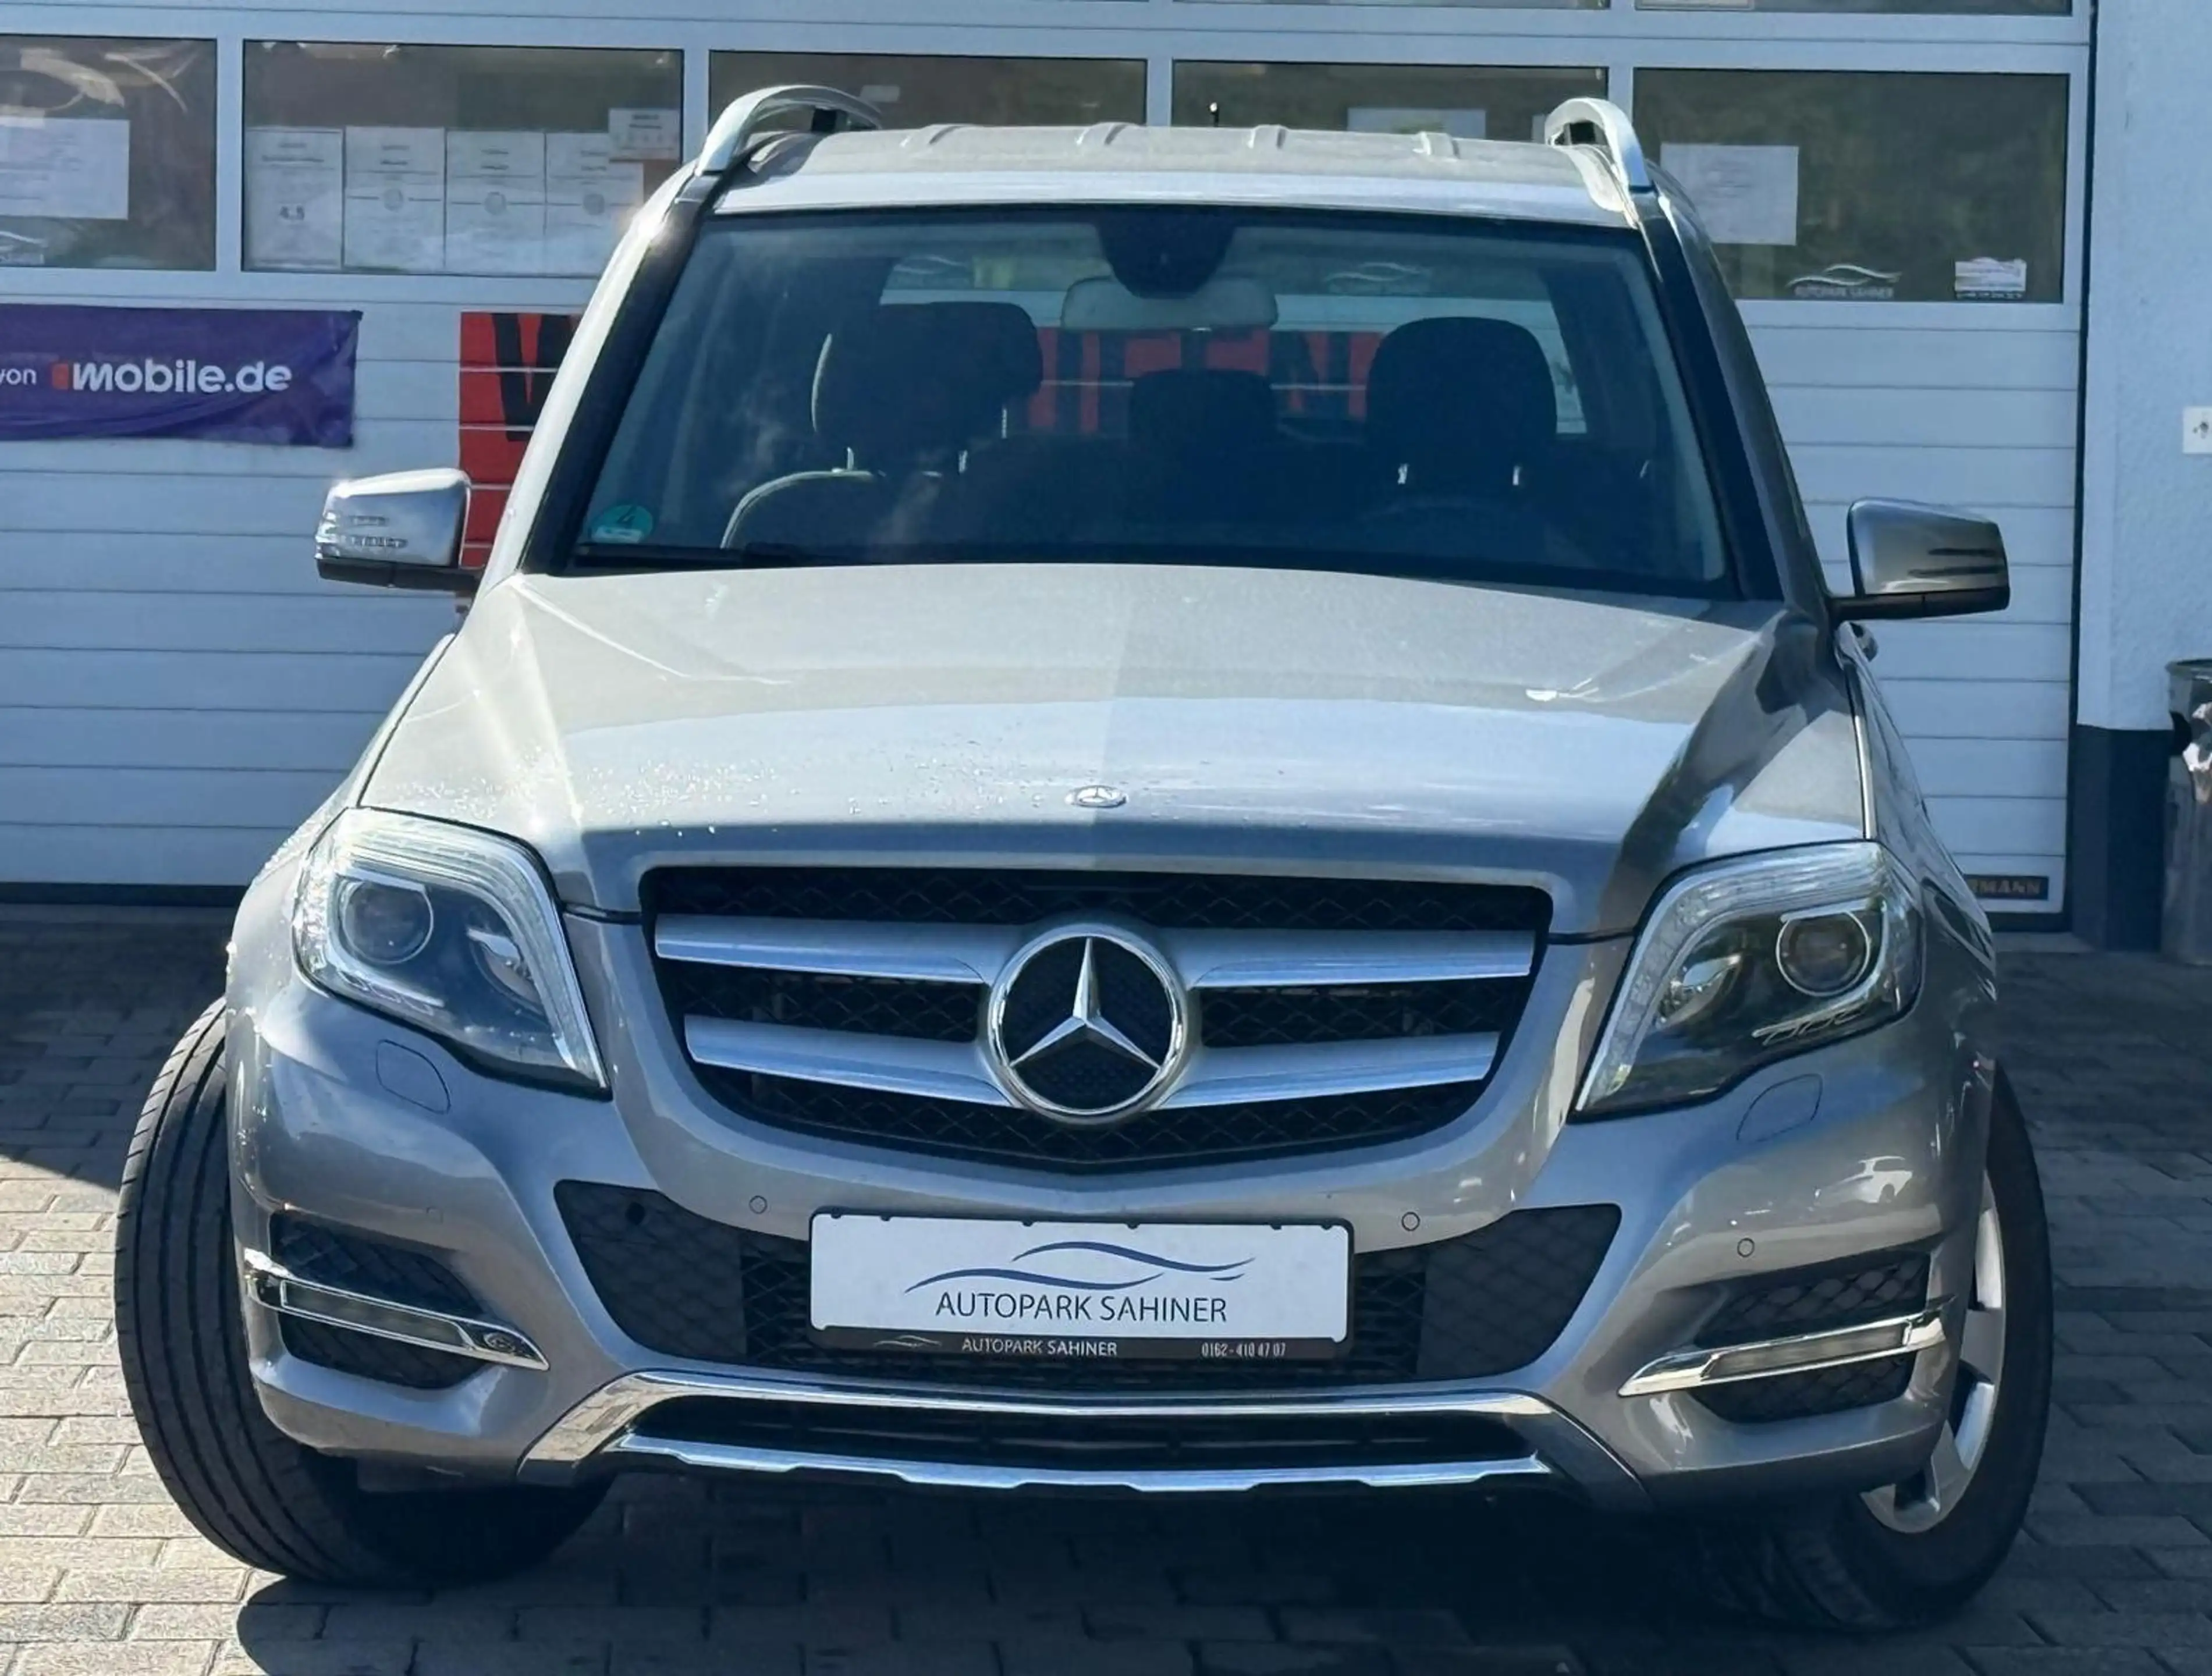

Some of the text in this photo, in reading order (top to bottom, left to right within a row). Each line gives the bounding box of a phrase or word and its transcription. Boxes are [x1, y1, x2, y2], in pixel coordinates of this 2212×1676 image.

[73, 358, 292, 393] mobile.de
[935, 1291, 1227, 1322] AUTOPARK SAHINER
[962, 1338, 1043, 1354] AUTOPARK
[1047, 1340, 1117, 1357] SAHINER
